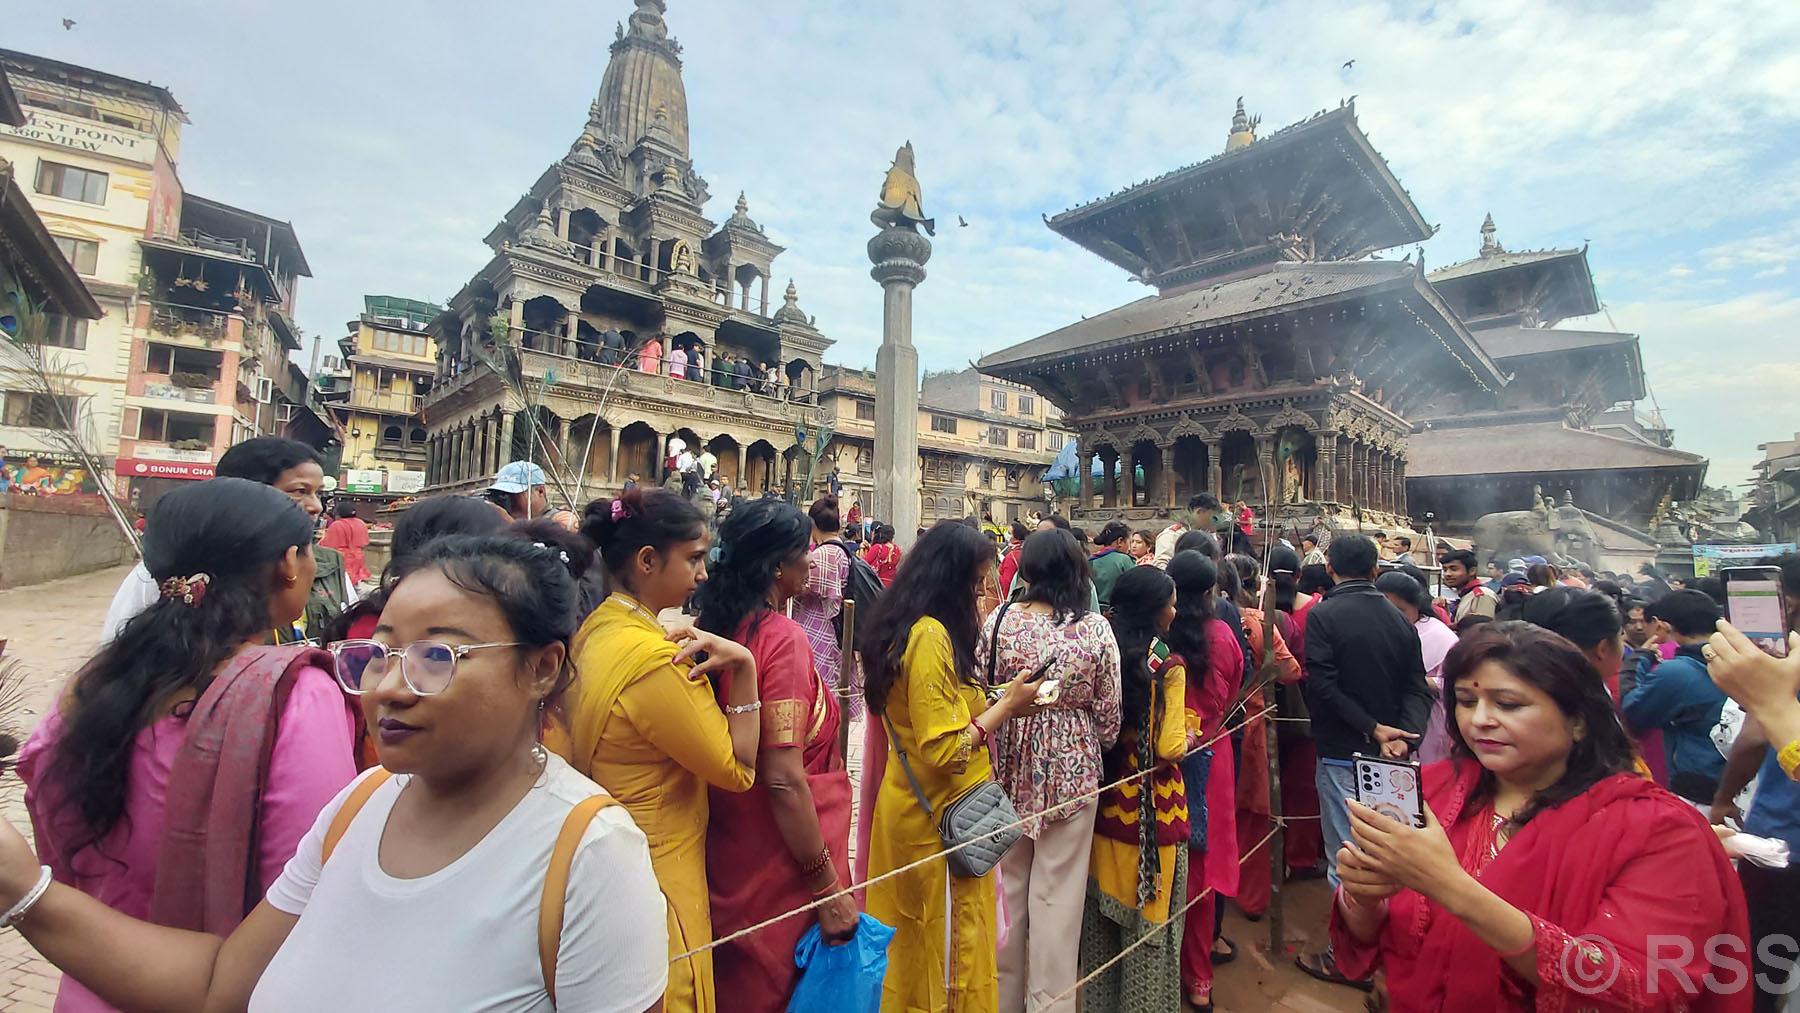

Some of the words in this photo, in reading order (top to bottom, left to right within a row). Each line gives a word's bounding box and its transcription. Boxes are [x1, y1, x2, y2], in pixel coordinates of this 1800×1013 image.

[45, 133, 102, 151] VIEW
[75, 127, 140, 148] POINT
[150, 465, 188, 474] BONUM
